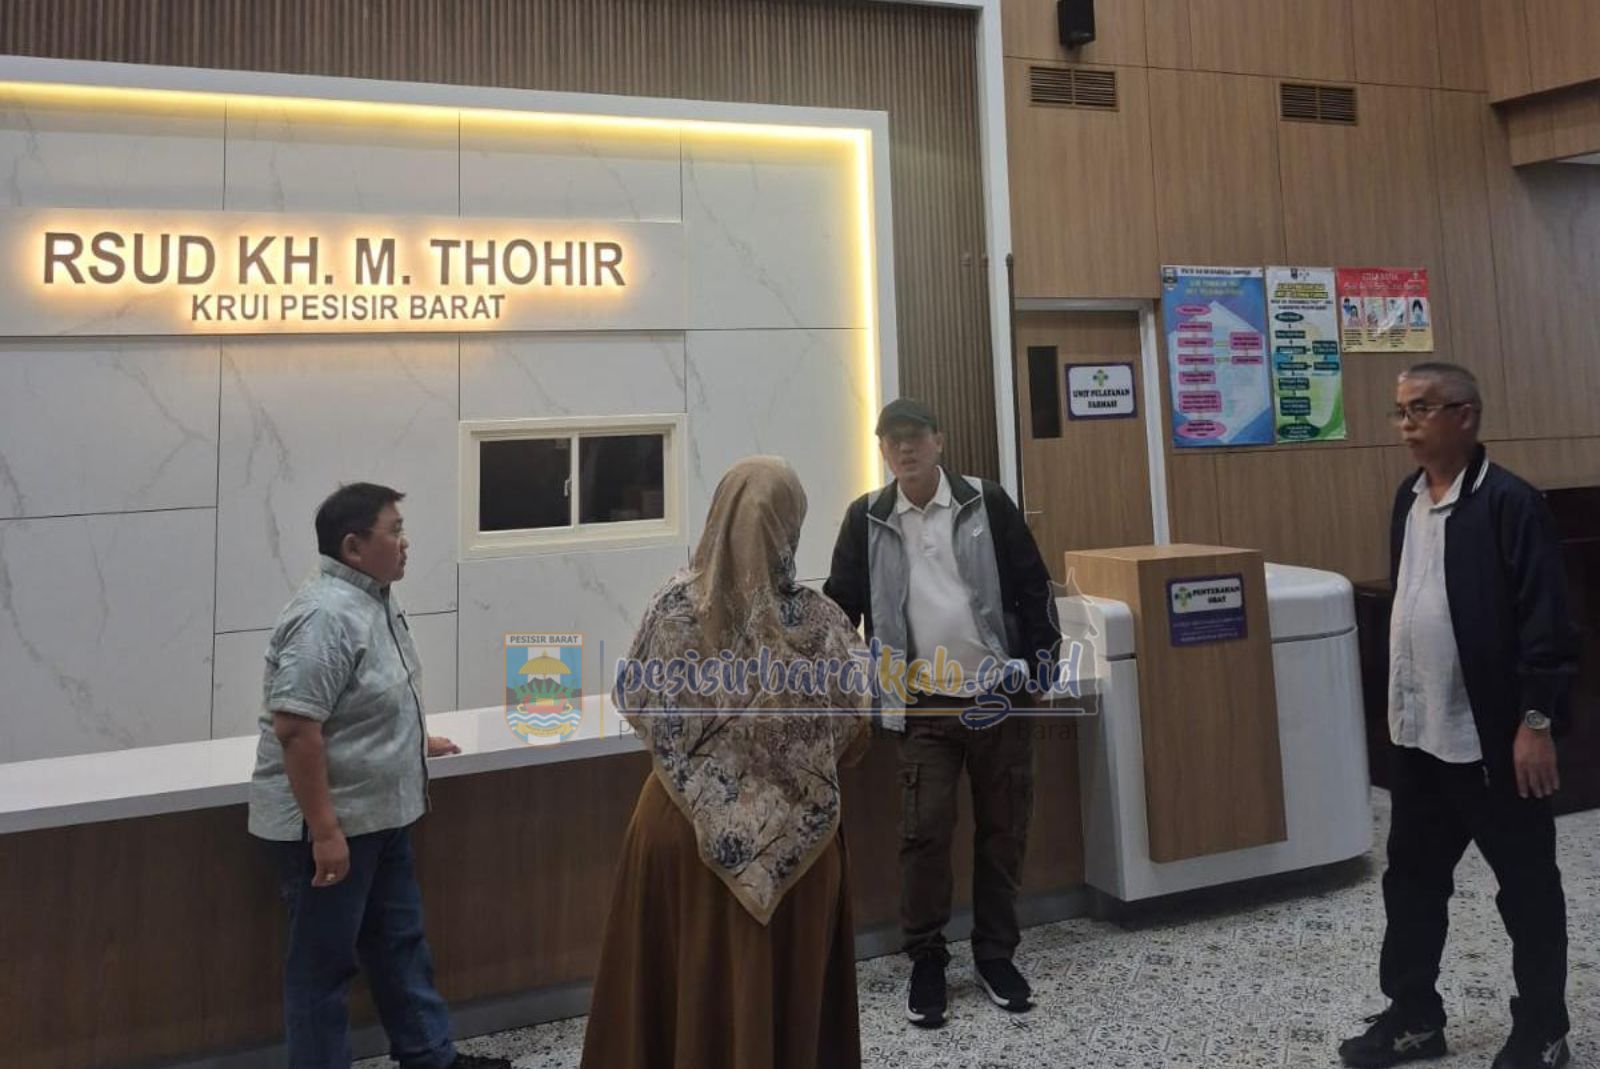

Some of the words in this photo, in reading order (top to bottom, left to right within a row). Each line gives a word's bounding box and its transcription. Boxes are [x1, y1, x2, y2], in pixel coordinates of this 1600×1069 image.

[44, 230, 215, 286] RSUD
[239, 235, 333, 285] KH.
[355, 237, 411, 286] M.
[430, 239, 627, 287] THOHIR
[191, 294, 268, 321] KRUI
[281, 294, 399, 321] PESISIR
[410, 294, 505, 320] BARAT
